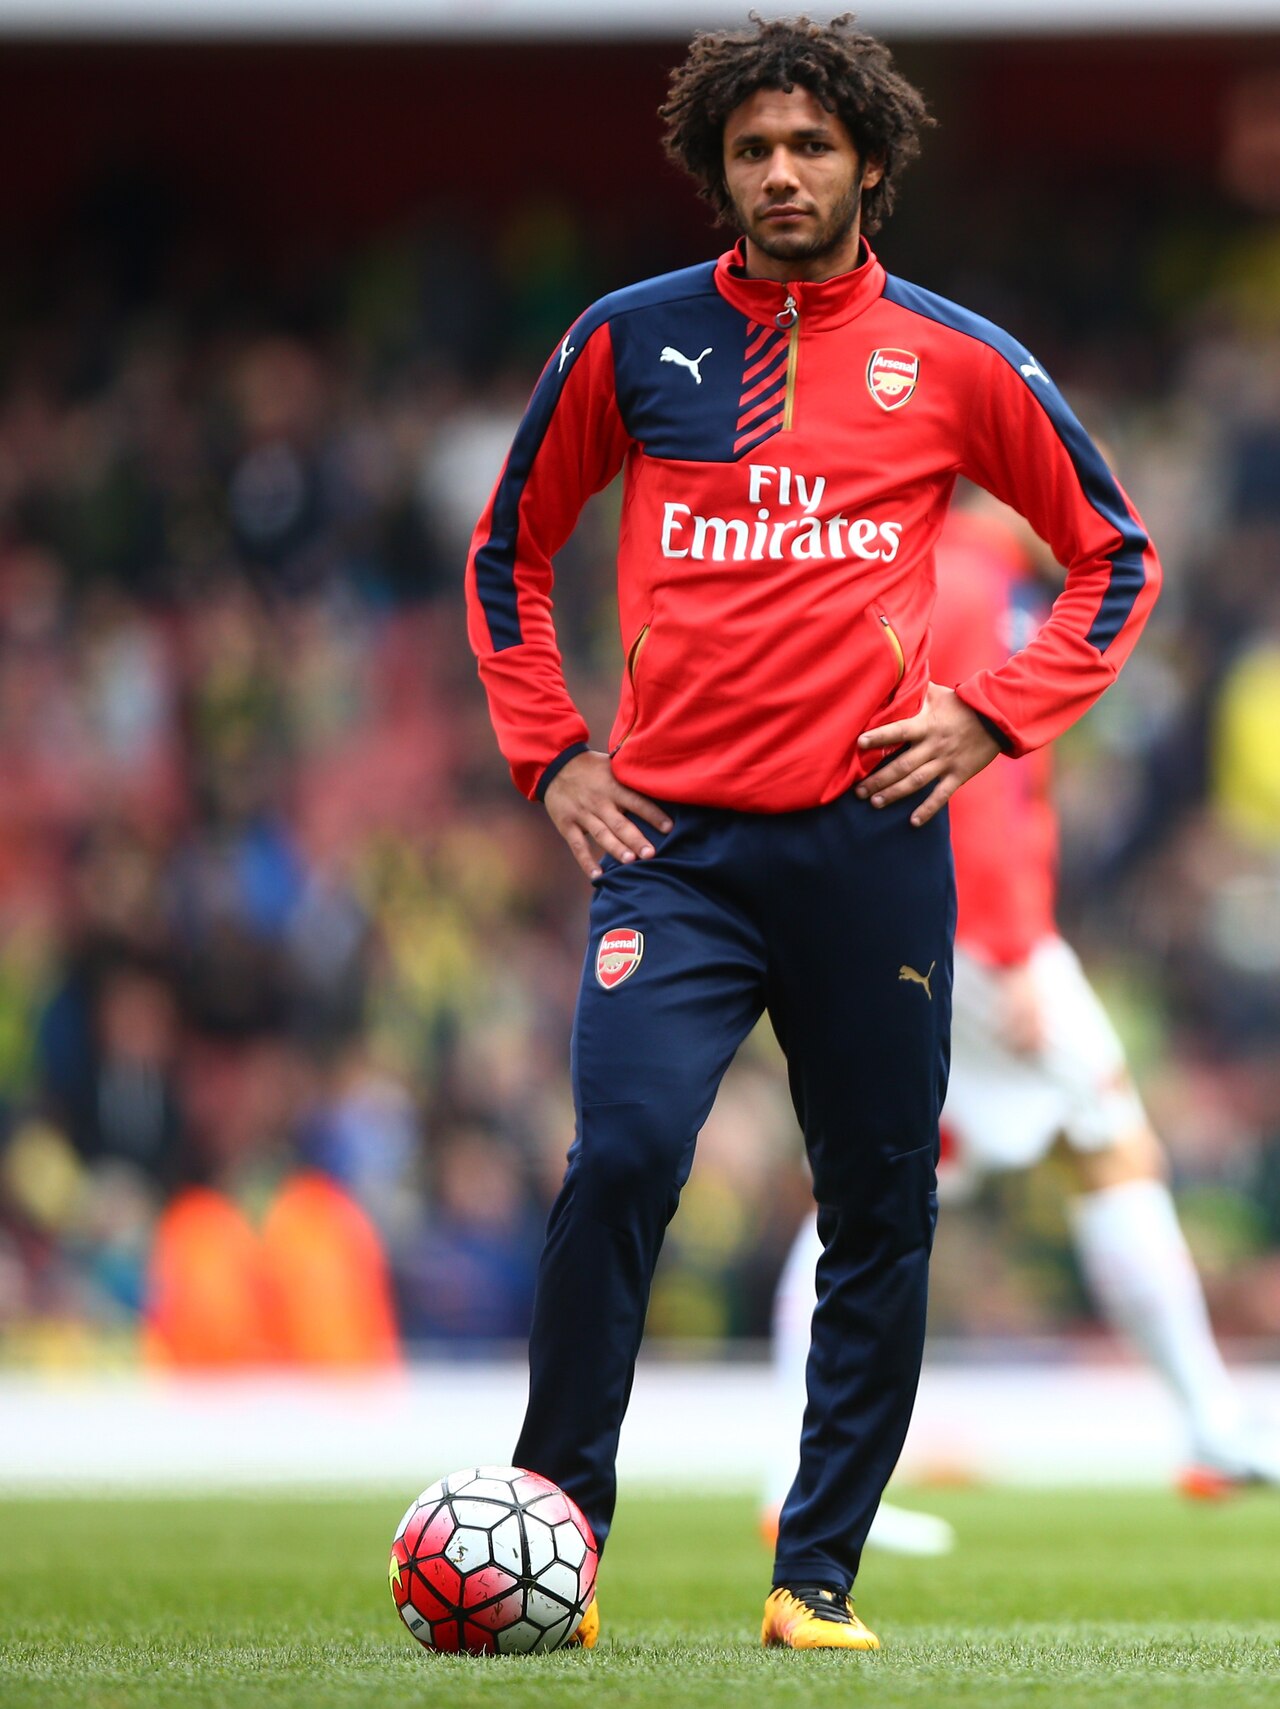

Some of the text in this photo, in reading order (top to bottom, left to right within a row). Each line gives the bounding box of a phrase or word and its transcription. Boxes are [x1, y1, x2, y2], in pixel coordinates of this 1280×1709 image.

[875, 356, 915, 374] Arsenal
[749, 464, 826, 514] Fly
[661, 502, 903, 562] Emirates
[602, 938, 636, 950] Arsenal
